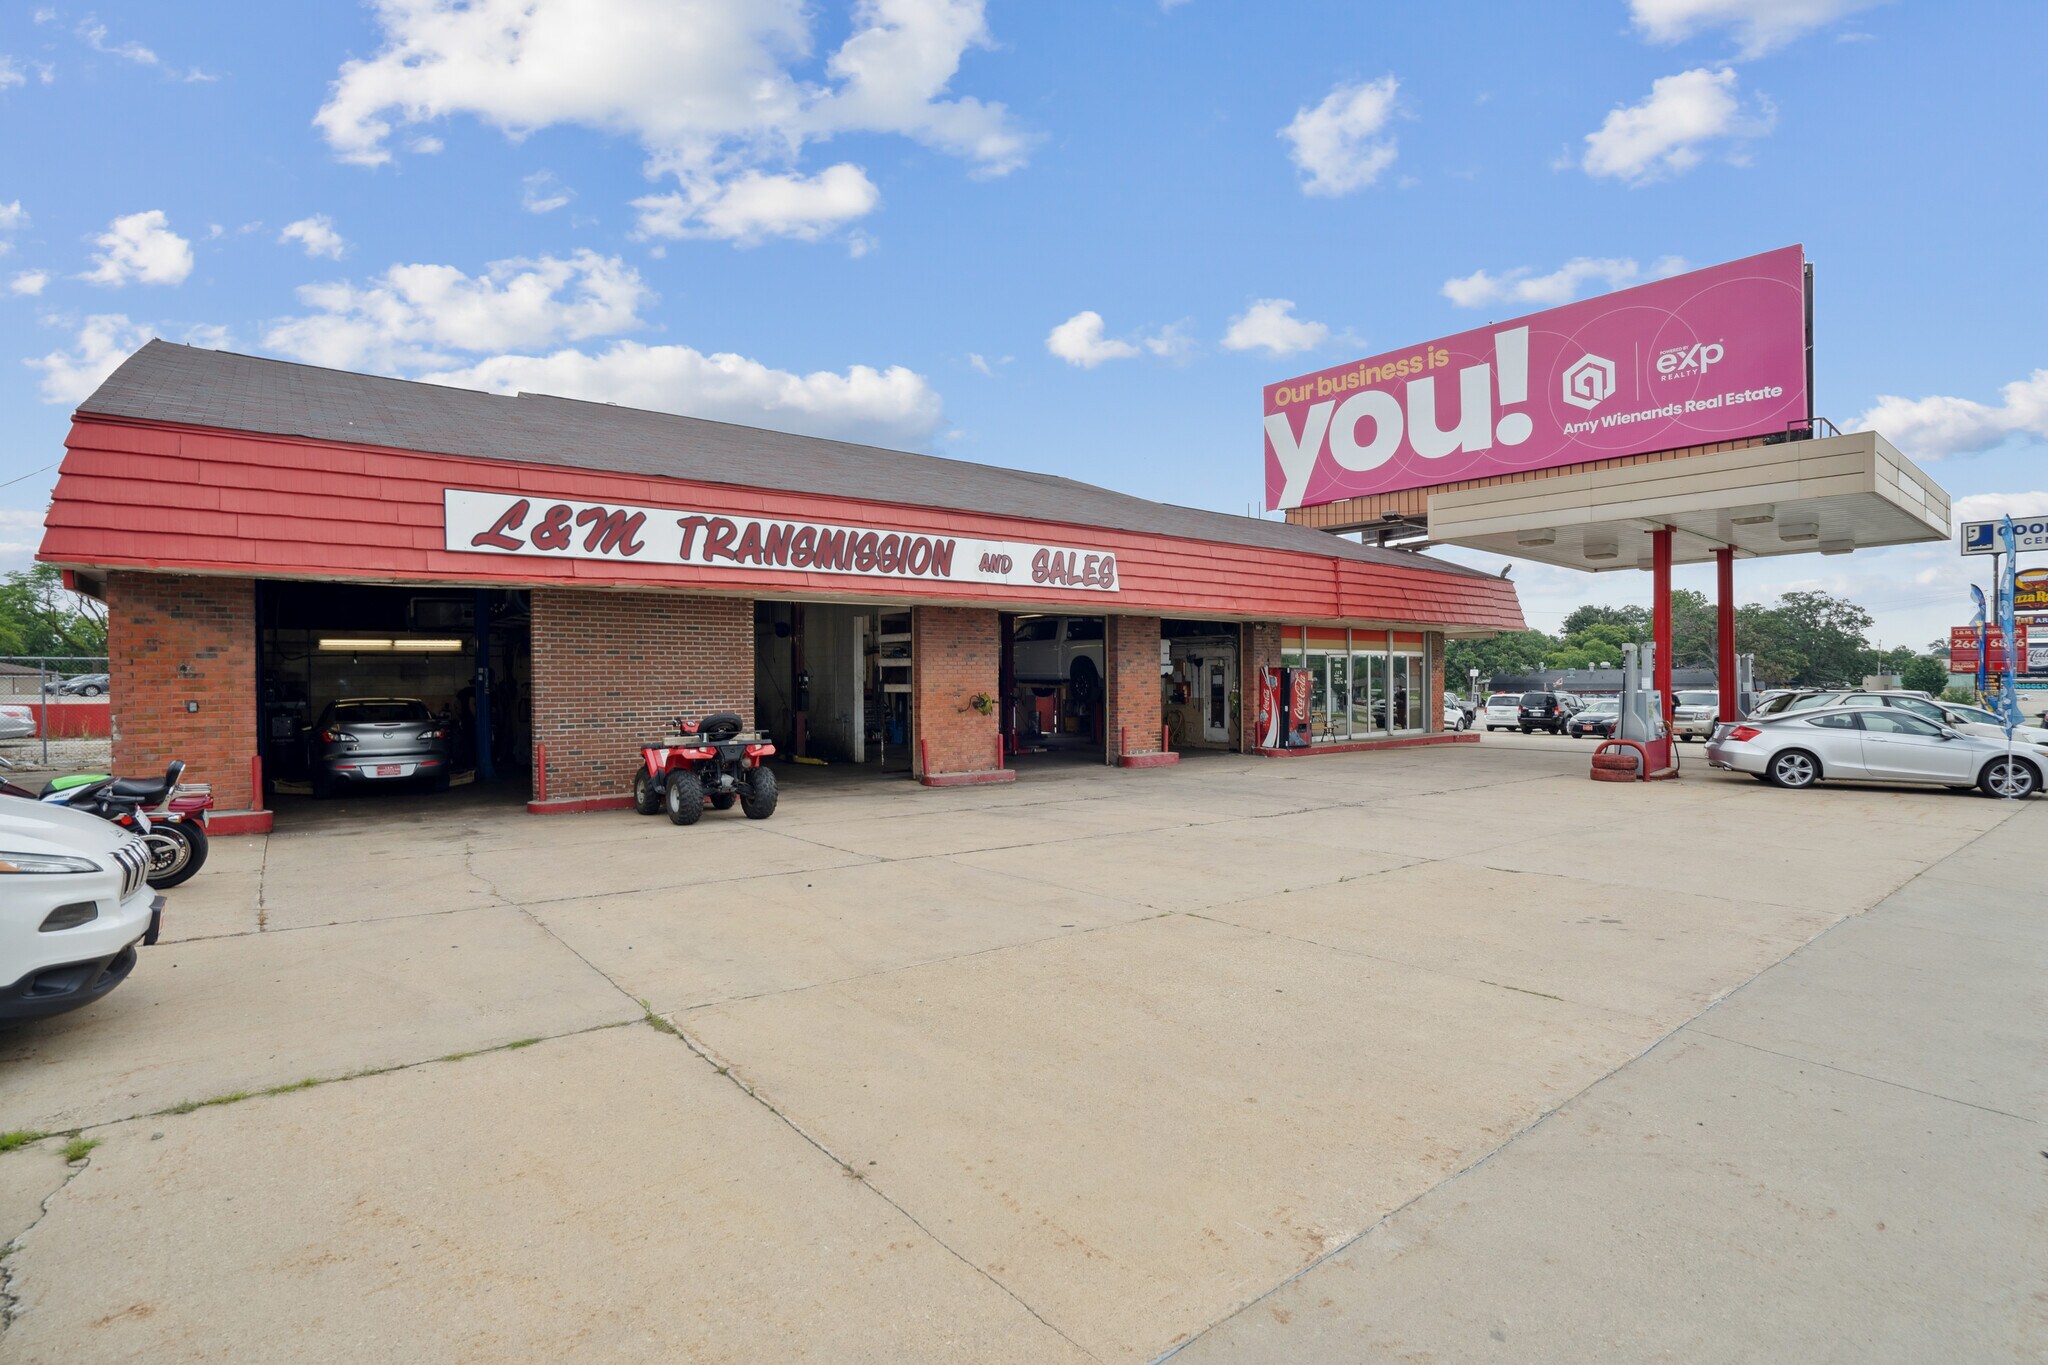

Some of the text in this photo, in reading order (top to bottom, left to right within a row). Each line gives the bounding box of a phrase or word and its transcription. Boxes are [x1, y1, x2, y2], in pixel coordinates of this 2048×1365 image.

[1275, 346, 1450, 407] Our business is
[1661, 369, 1698, 381] REALTY
[1264, 325, 1534, 510] you!
[1563, 385, 1783, 437] Amy Wienands Real Estate
[472, 498, 1117, 590] L&M TRANSMISSION AND SALES
